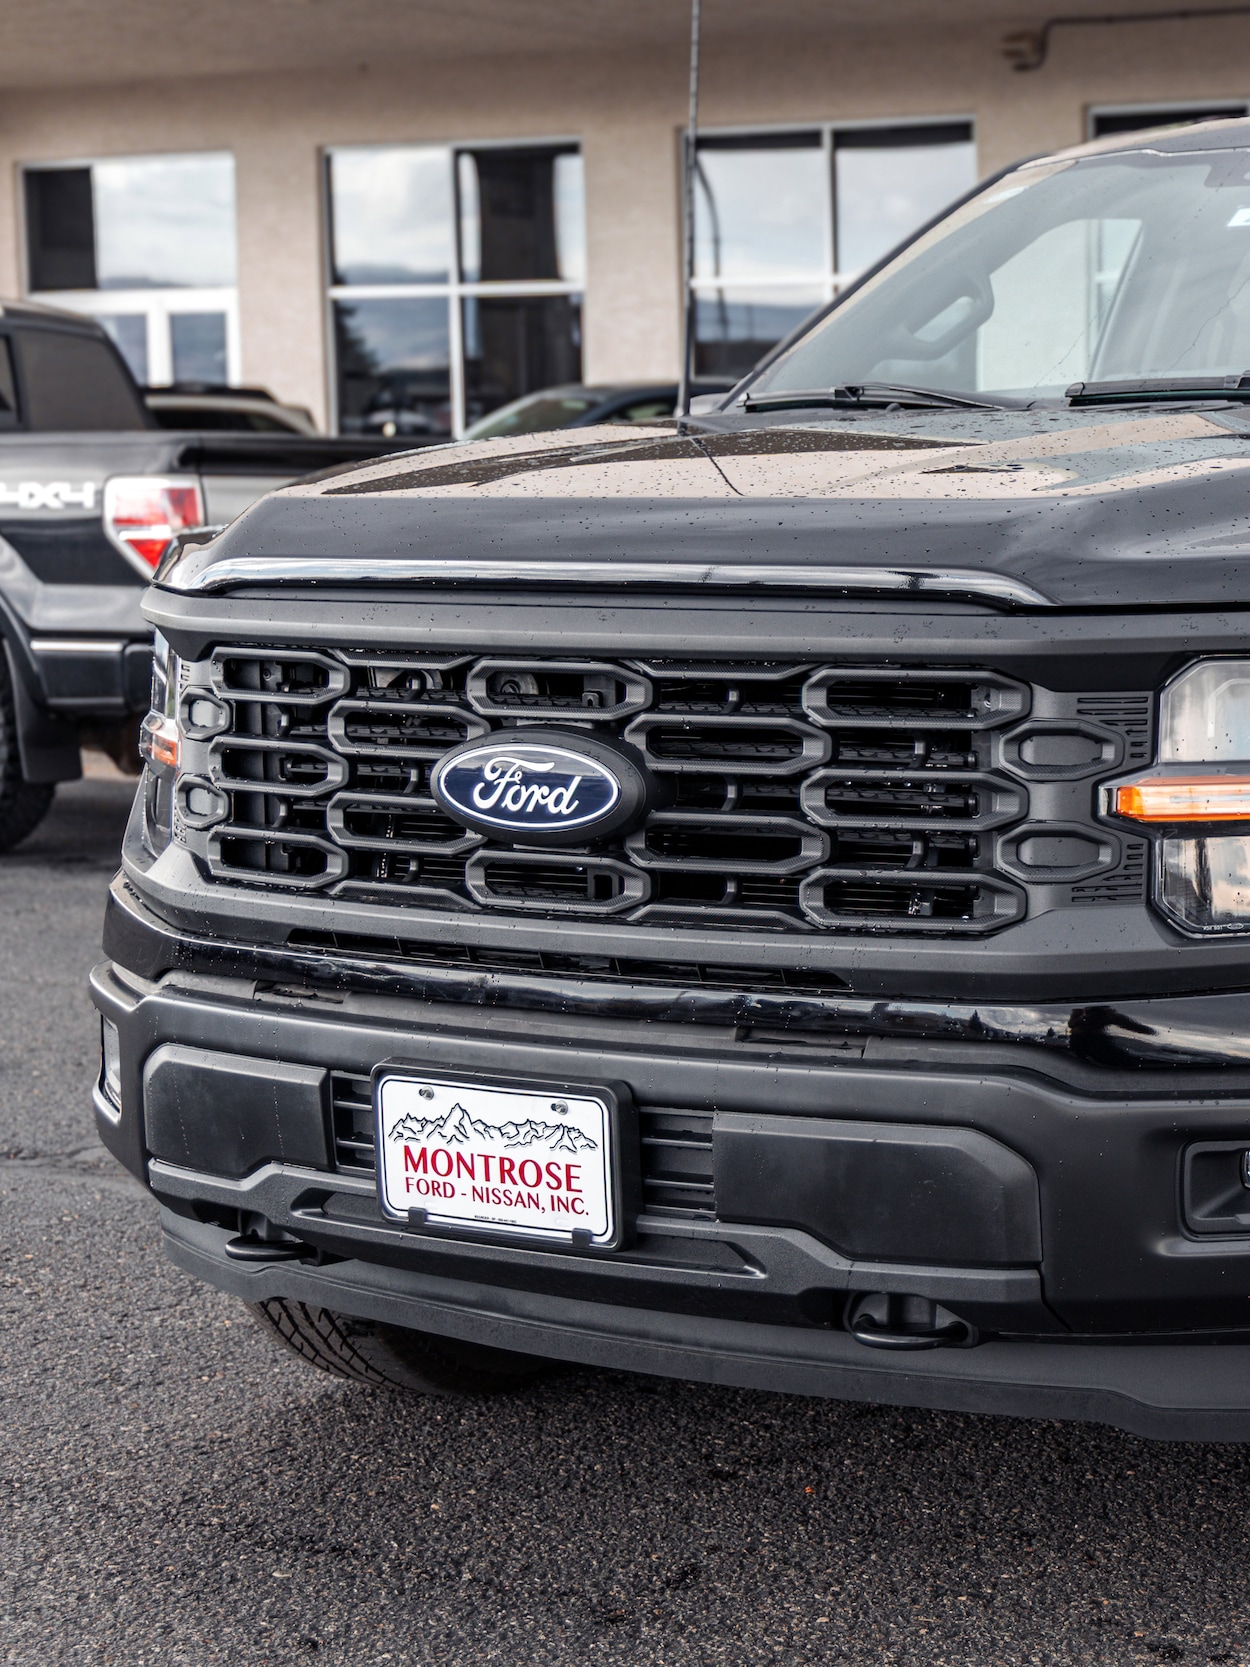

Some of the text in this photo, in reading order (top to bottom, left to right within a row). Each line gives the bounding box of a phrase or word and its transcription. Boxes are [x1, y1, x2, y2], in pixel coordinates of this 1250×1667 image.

[473, 756, 582, 815] Ford
[403, 1145, 583, 1193] MONTROSE
[405, 1177, 456, 1199] FORD
[472, 1185, 546, 1214] NISSAN,
[550, 1195, 590, 1216] INC.
